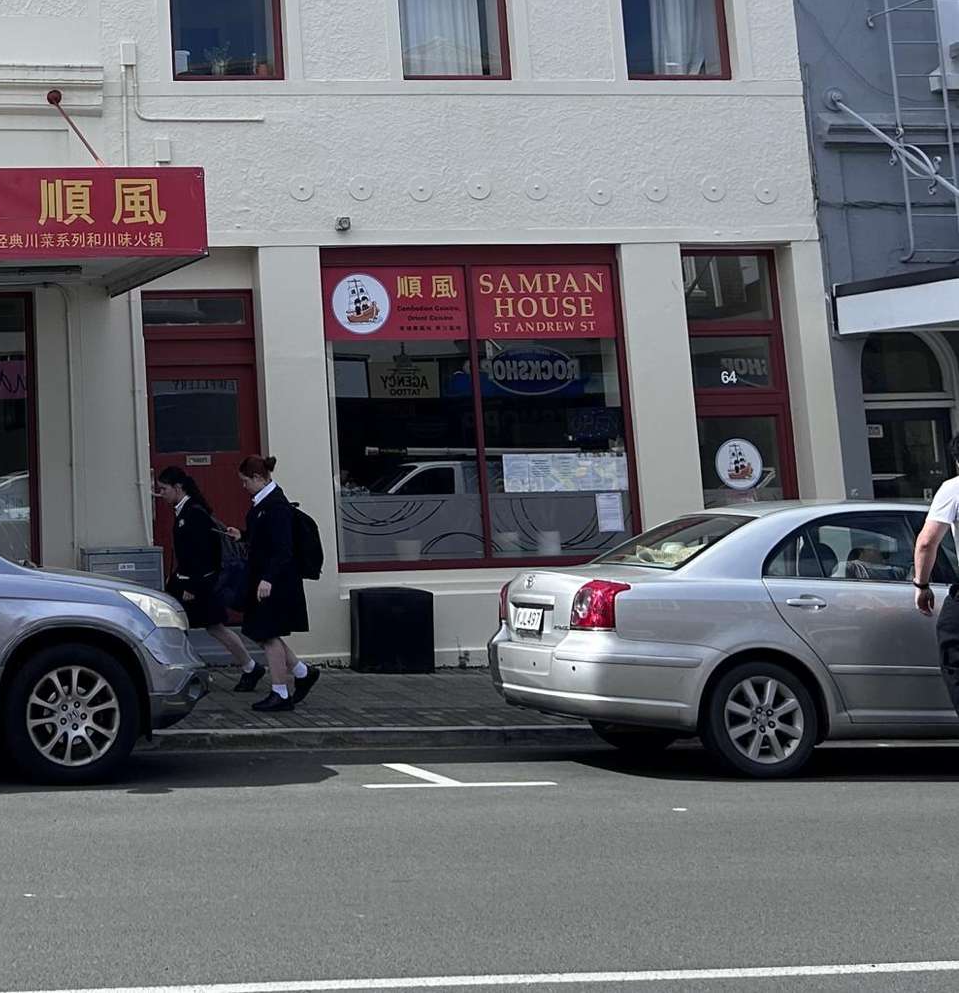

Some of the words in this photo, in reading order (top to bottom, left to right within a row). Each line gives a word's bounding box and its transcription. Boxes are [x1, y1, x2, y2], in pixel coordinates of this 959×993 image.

[38, 178, 167, 226] 順風
[396, 275, 458, 298] 順風
[479, 273, 604, 294] SAMPAN
[493, 296, 595, 318] HOUSE
[493, 321, 511, 333] ST
[515, 320, 575, 332] ANDREW
[580, 320, 597, 332] ST
[721, 371, 737, 384] 64
